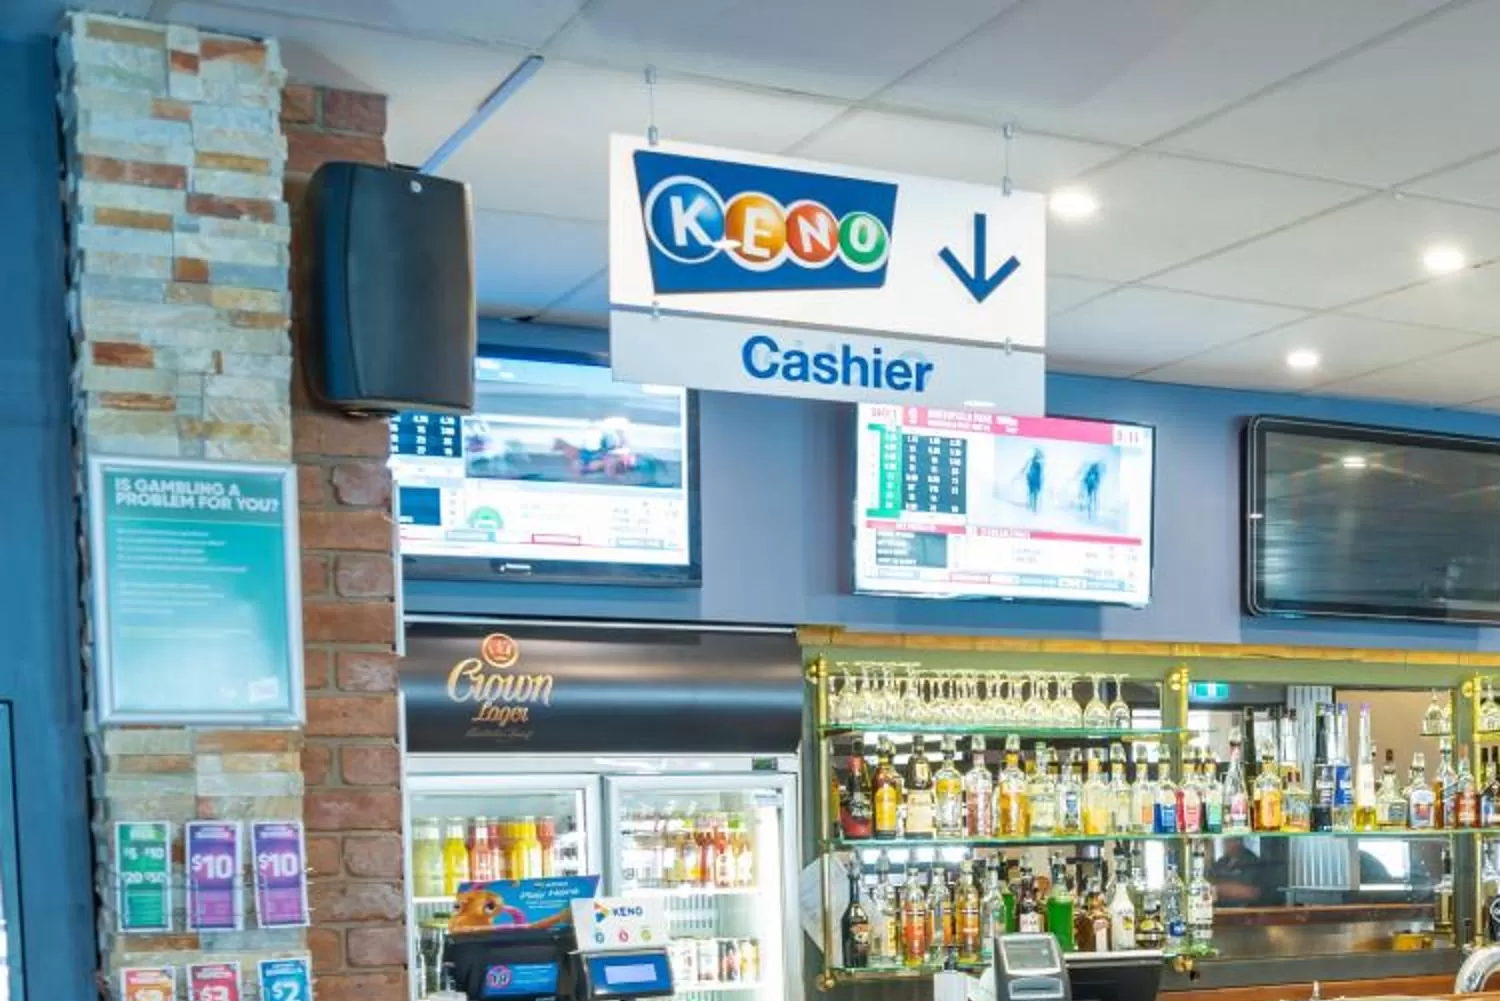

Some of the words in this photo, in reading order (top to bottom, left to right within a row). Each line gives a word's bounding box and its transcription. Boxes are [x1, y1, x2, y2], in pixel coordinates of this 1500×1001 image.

[664, 191, 881, 262] KENO
[741, 335, 934, 392] Cashier
[115, 477, 131, 492] IS
[134, 478, 224, 496] GAMBLING
[228, 483, 241, 497] A
[115, 491, 195, 508] PROBLEM
[198, 495, 233, 510] FOR
[237, 498, 280, 513] YOU?
[448, 657, 553, 708] Crown
[472, 703, 528, 727] Lager
[191, 854, 234, 880] $10
[258, 852, 298, 878] $10
[612, 905, 643, 918] KENO
